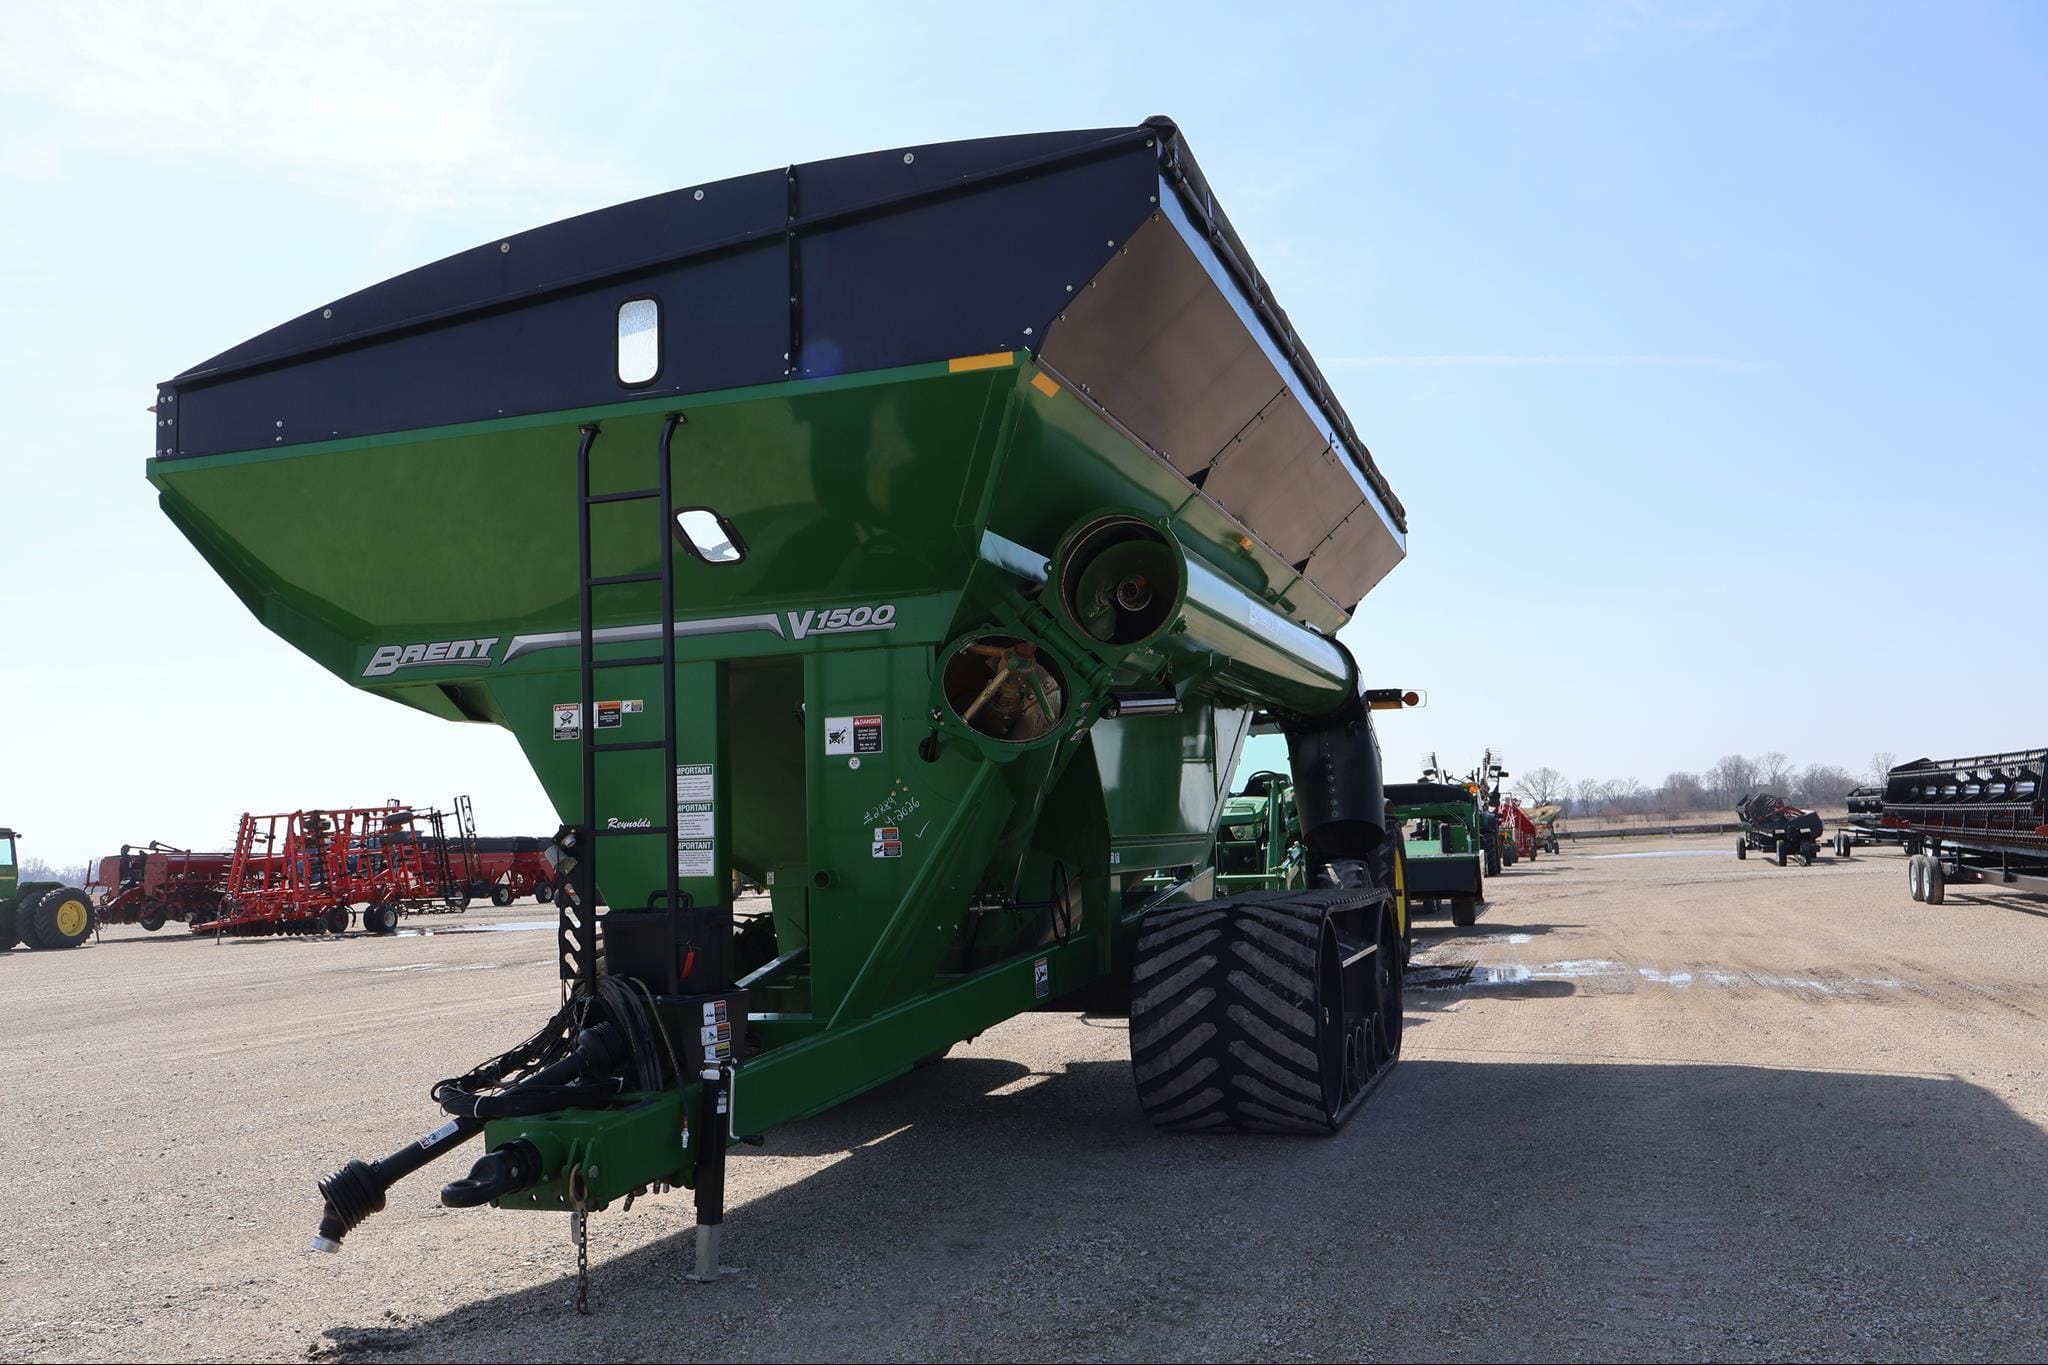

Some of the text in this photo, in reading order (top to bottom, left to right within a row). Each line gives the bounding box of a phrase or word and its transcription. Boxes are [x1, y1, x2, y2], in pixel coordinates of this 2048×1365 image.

[787, 604, 896, 640] V1500
[362, 637, 499, 677] BRENT
[677, 766, 711, 775] MPORTANT
[677, 803, 712, 812] MPORTANT
[607, 817, 651, 830] Reynolds
[678, 841, 712, 850] MPORTANT
